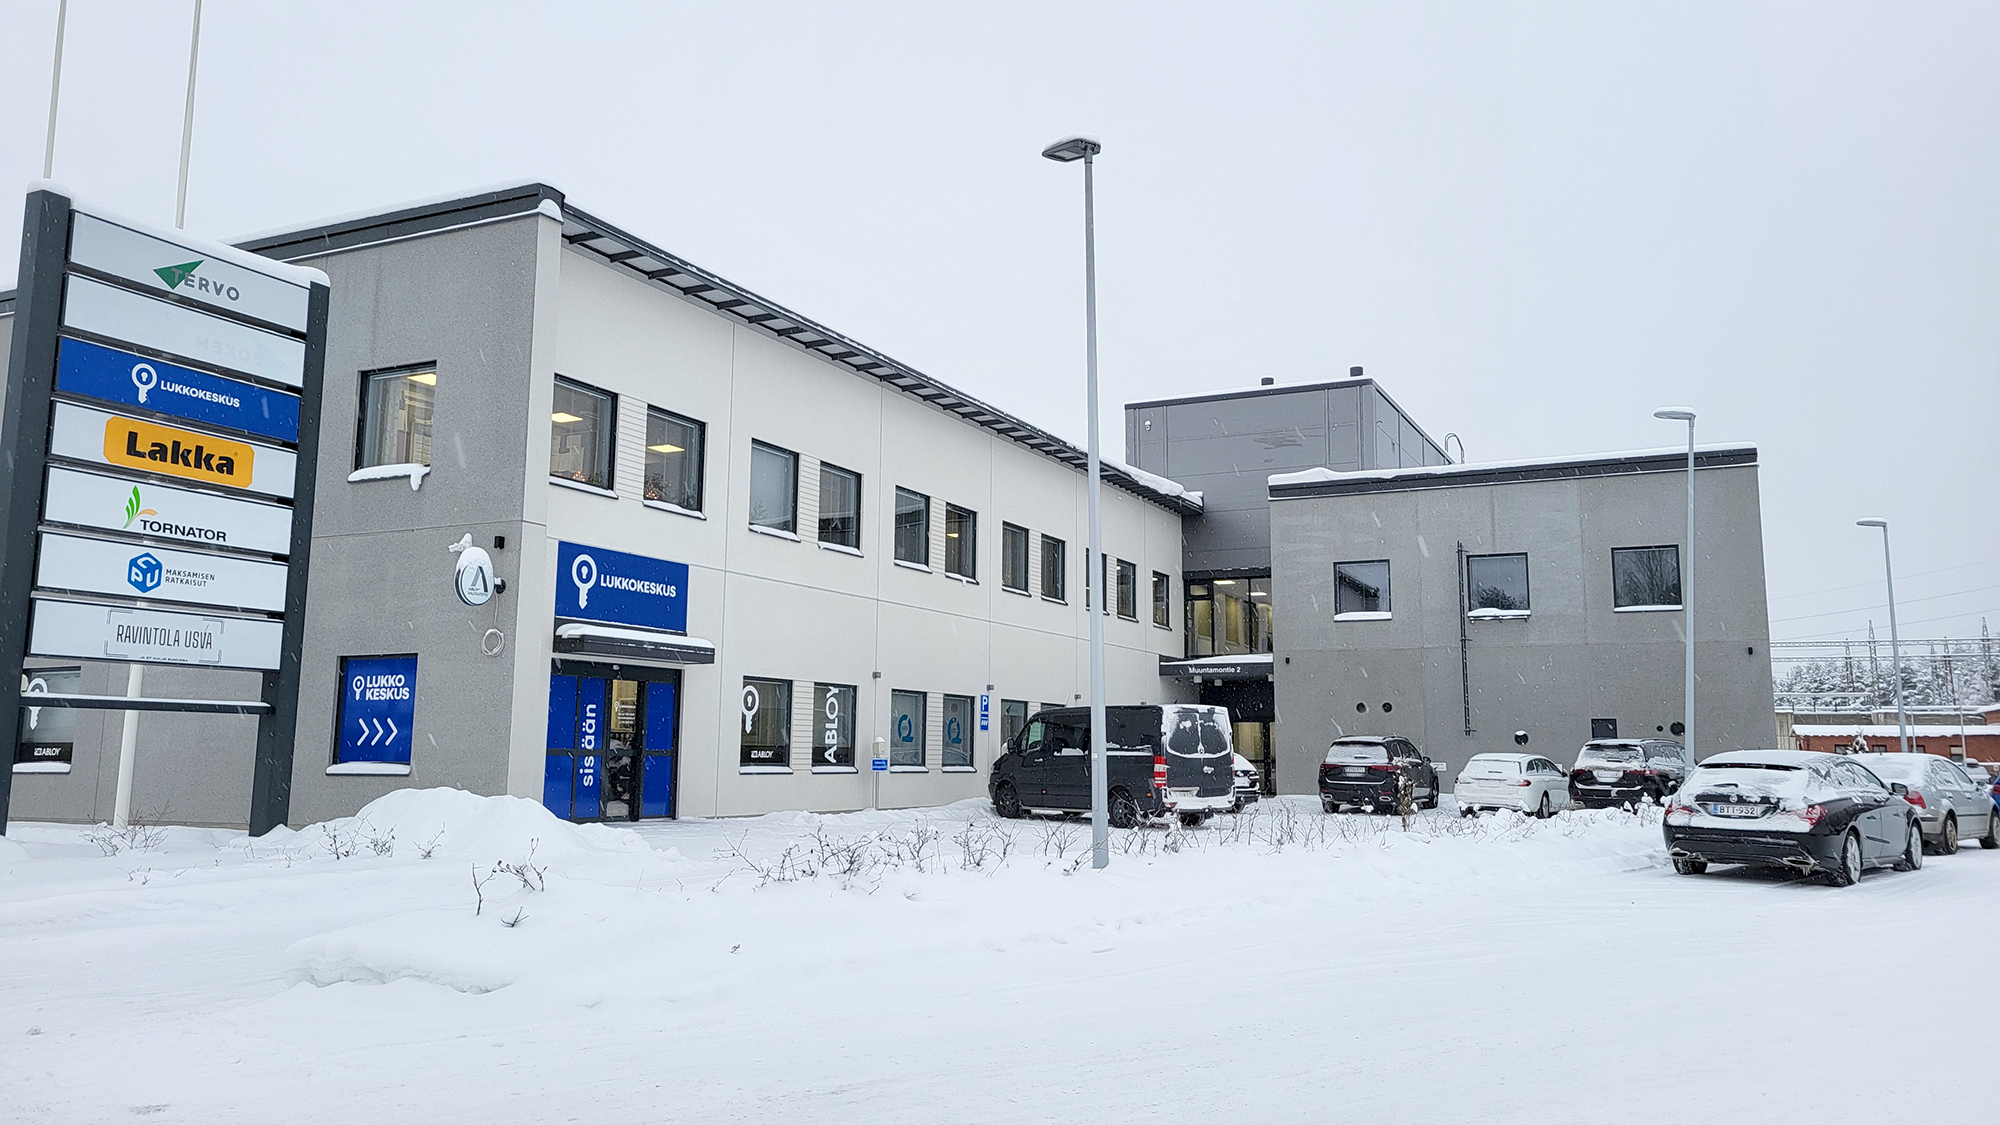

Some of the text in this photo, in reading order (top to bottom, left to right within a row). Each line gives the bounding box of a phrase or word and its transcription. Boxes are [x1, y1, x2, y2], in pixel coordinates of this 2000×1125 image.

[171, 267, 240, 301] TERVO
[160, 380, 240, 407] LUKKOKESKUS
[126, 431, 234, 475] Lakka
[140, 519, 227, 542] TORNATOR
[165, 569, 215, 581] MAKSAMISEN
[165, 576, 207, 587] RATKAISUT
[600, 574, 677, 597] LUKKOKESKUS
[116, 624, 212, 650] RAVINTOLA USVA
[1188, 666, 1235, 674] Muuntamontie
[366, 674, 405, 688] LUKKO
[365, 687, 410, 700] KESKUS
[982, 695, 988, 711] P
[824, 686, 839, 764] ABLOY
[1719, 805, 1756, 815] BTT-932
